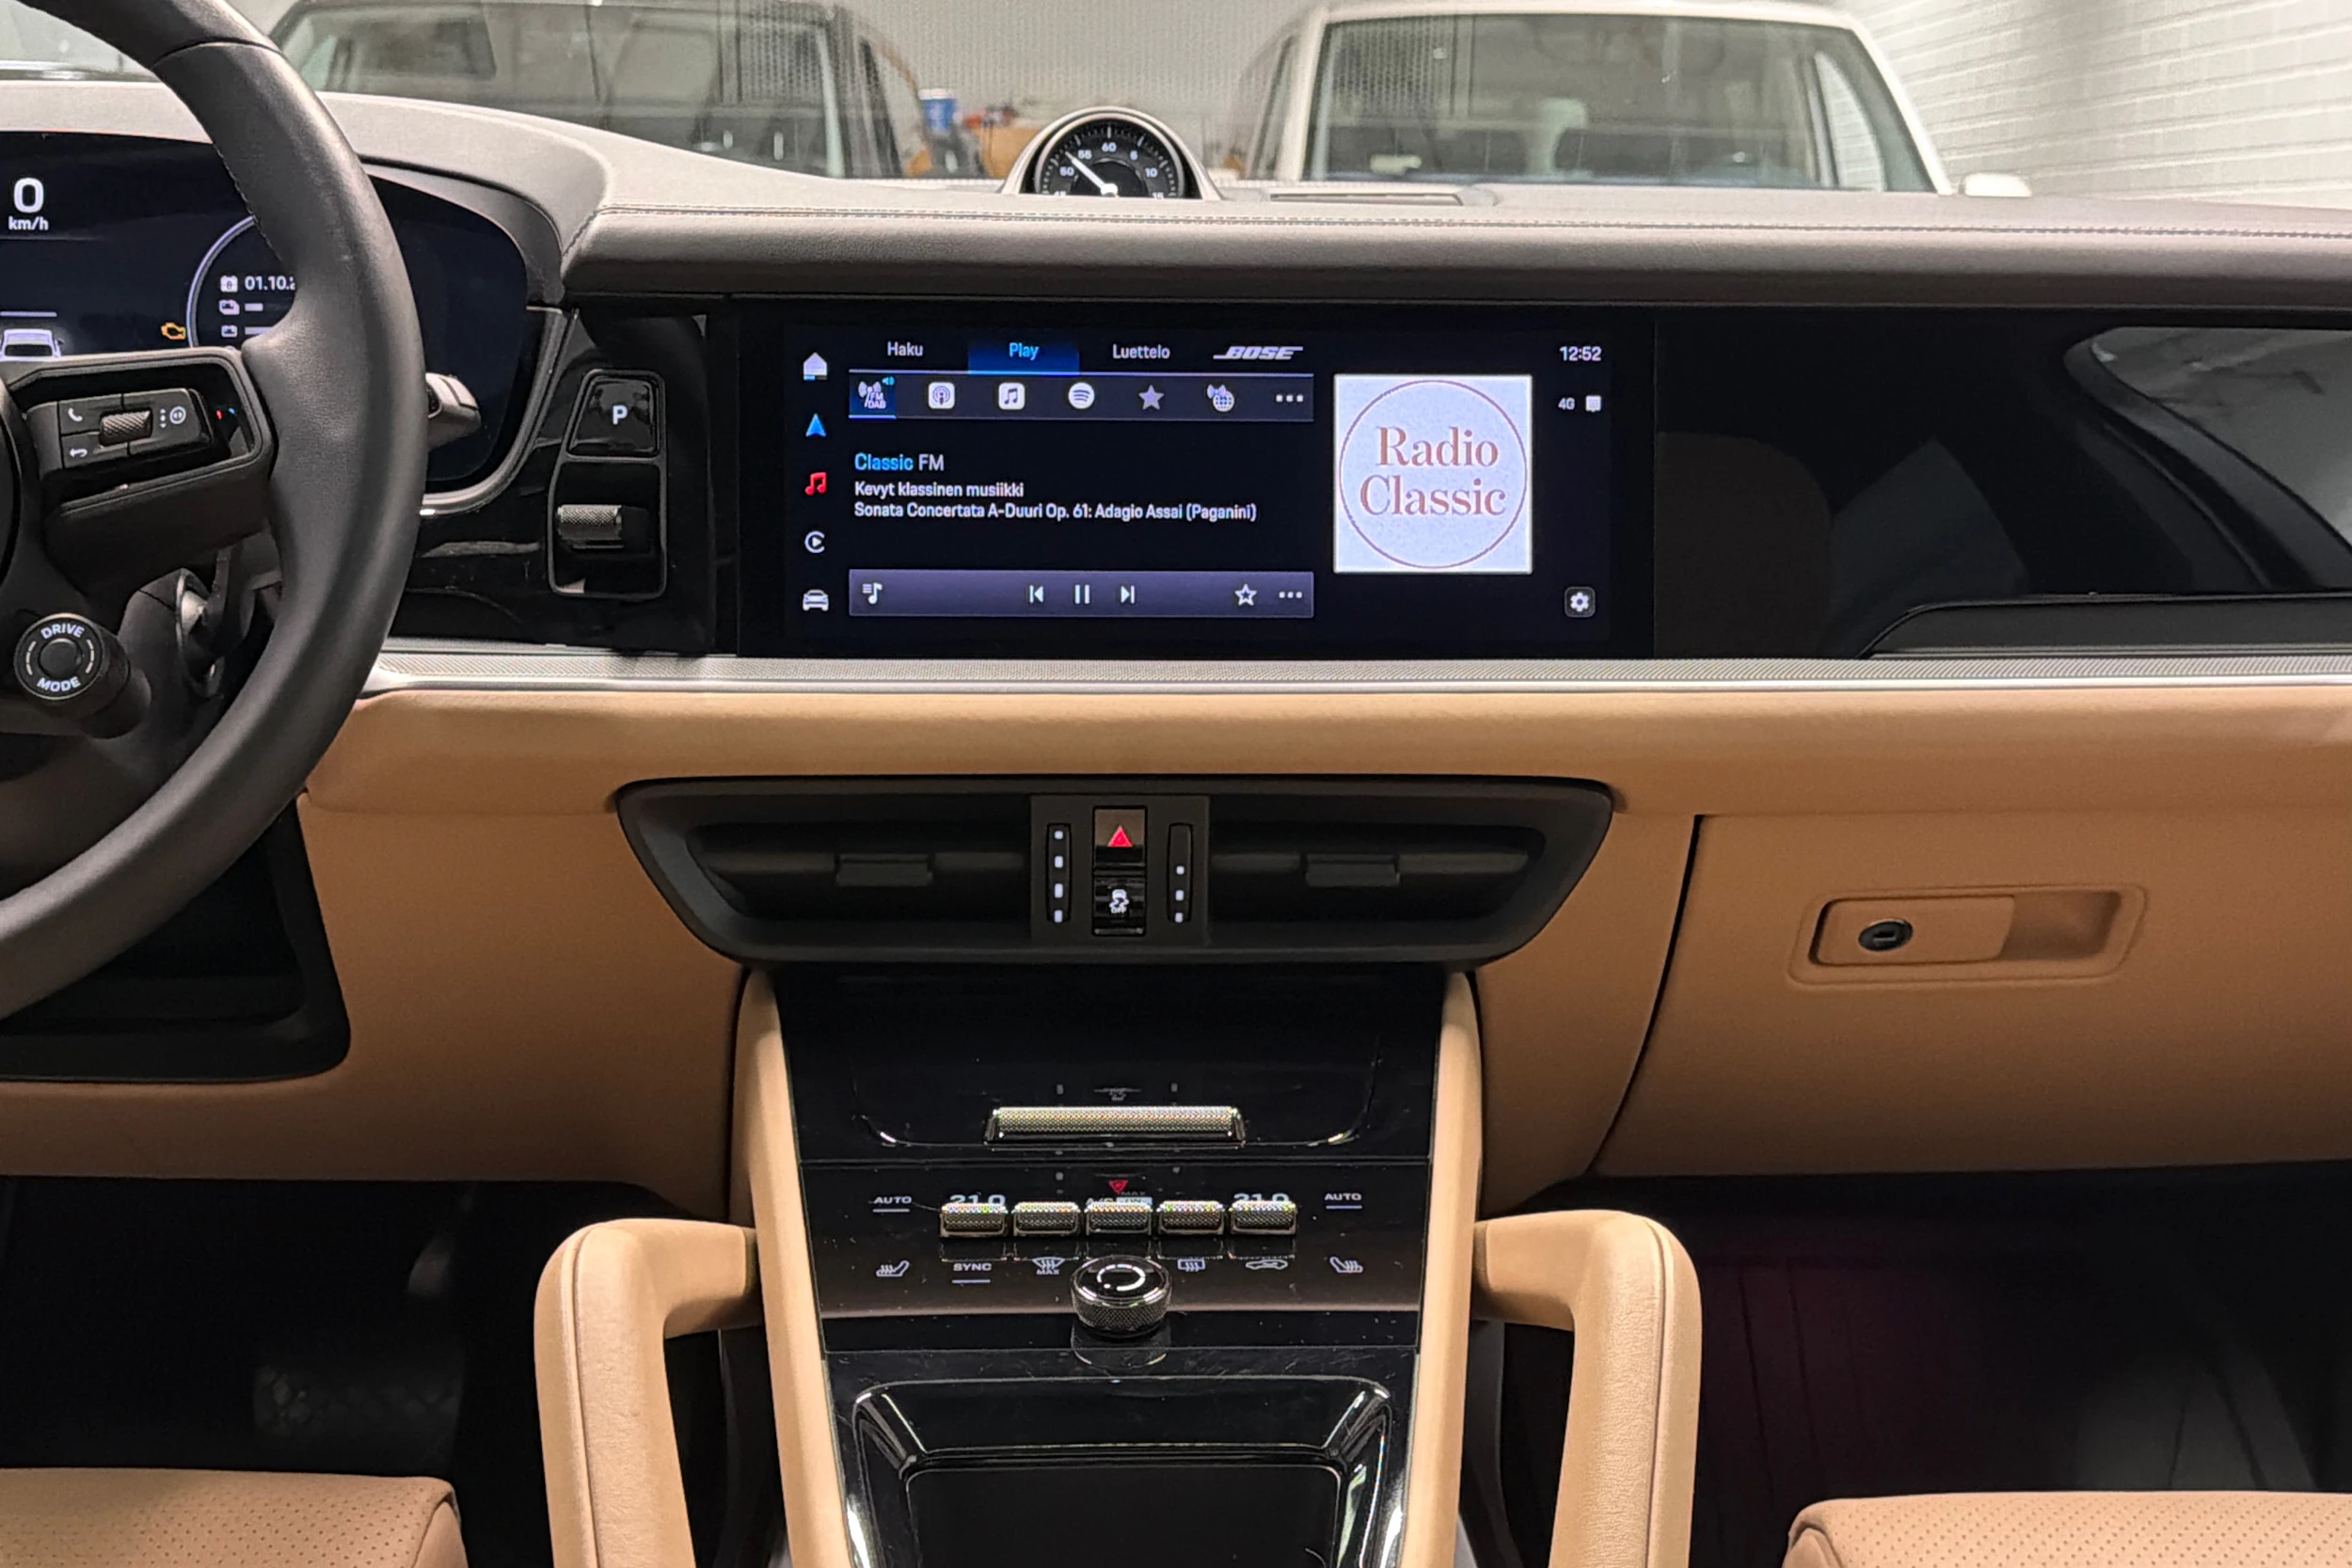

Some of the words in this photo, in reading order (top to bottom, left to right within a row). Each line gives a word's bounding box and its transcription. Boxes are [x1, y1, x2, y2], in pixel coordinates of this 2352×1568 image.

[1145, 167, 1158, 178] 10
[14, 177, 44, 214] 0
[8, 214, 49, 230] km/h
[886, 341, 924, 357] Haku
[1009, 341, 1040, 361] Play
[1112, 343, 1170, 360] Luettelo
[1213, 345, 1304, 360] BOSE
[1559, 345, 1602, 362] 12:52
[612, 404, 628, 425] P
[1375, 425, 1499, 467] Radio
[854, 452, 914, 471] Classic
[918, 453, 945, 471] FM
[854, 481, 896, 499] Kevyt
[898, 482, 962, 497] klassinen
[965, 482, 1025, 498] musiikki
[1359, 474, 1506, 516] Classic
[854, 501, 903, 517] Sonata
[907, 502, 985, 518] Concertata
[988, 502, 1043, 518] A-Duuri
[1045, 503, 1070, 522] Op.
[1073, 503, 1092, 518] 61:
[1094, 503, 1143, 522] Adagio
[1145, 503, 1183, 519] Assai
[1185, 503, 1257, 522] (Paganini)
[40, 623, 85, 640] DRIVE
[37, 675, 82, 692] MODE
[873, 1196, 913, 1205] AUTO
[1324, 1193, 1362, 1202] AUTO
[953, 1262, 993, 1272] SYNC
